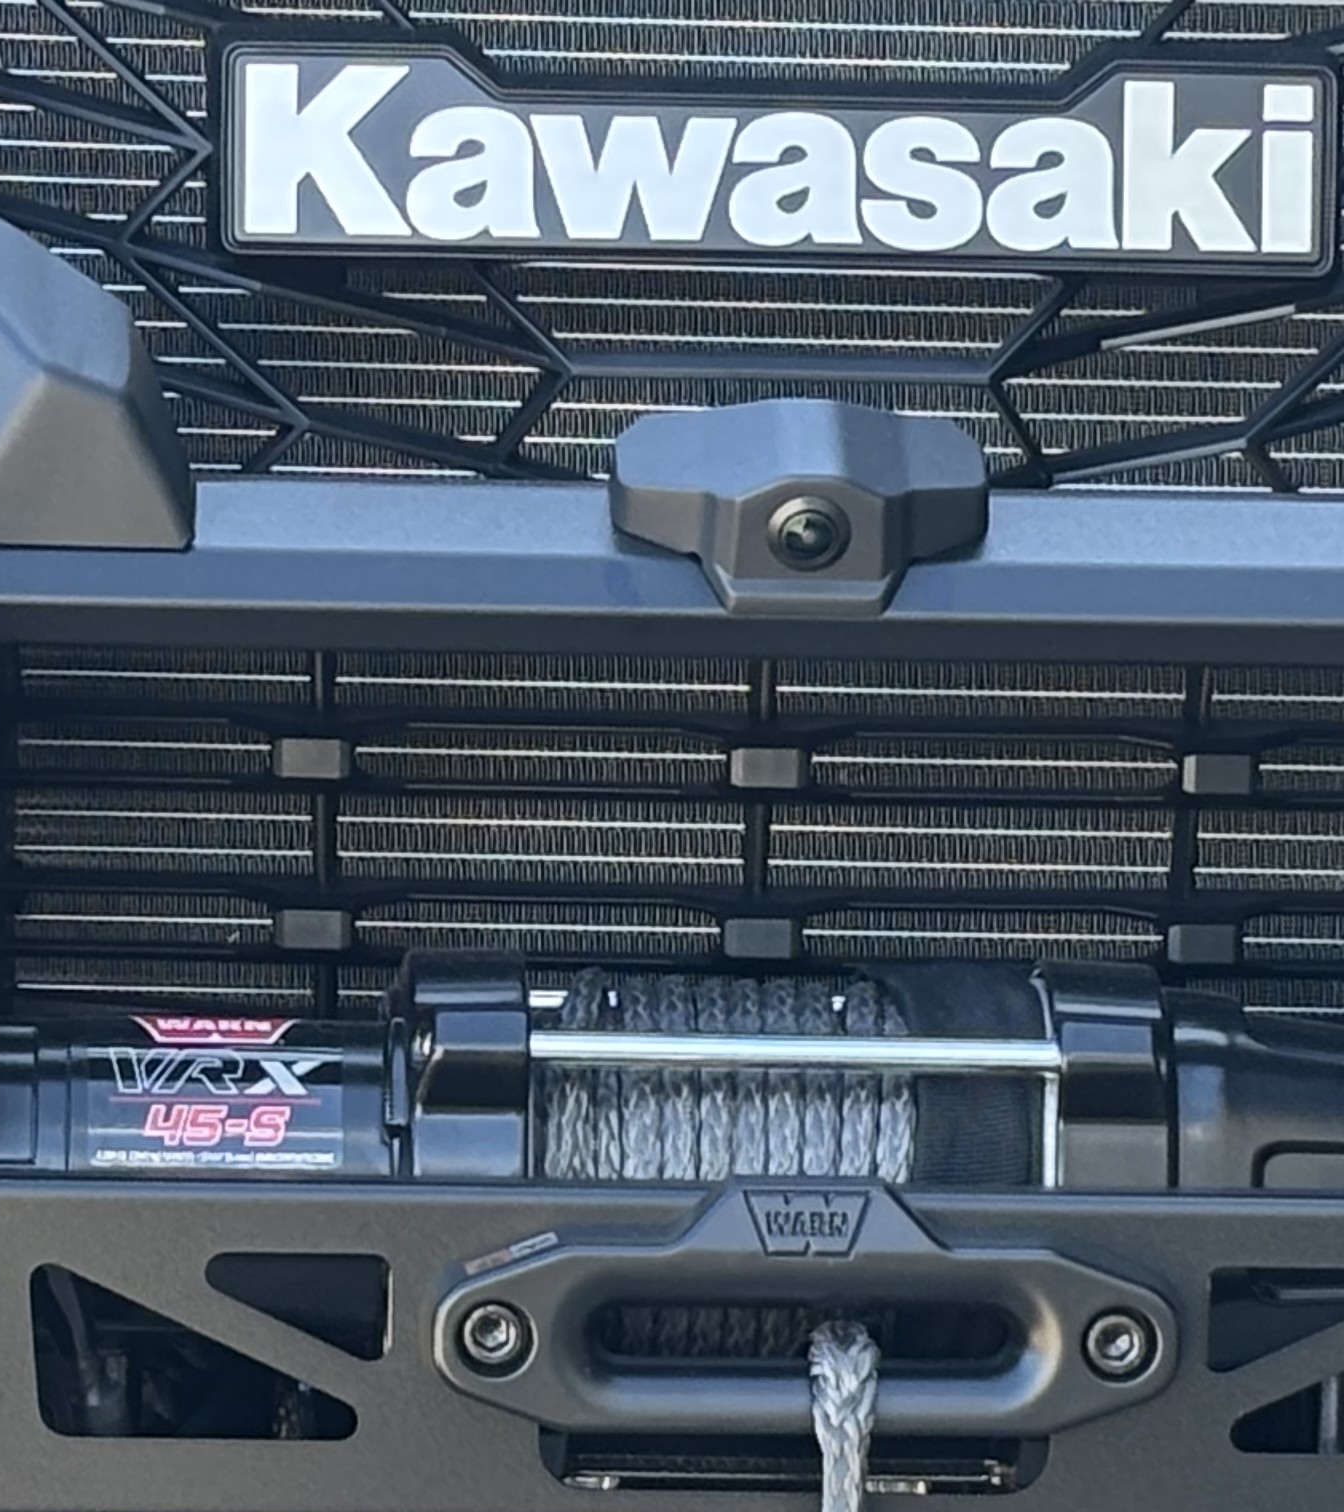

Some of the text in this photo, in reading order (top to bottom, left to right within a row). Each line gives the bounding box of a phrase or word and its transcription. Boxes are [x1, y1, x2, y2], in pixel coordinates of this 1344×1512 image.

[243, 62, 1314, 253] Kawasaki
[157, 1020, 272, 1032] WARN
[108, 1047, 324, 1095] VRX
[143, 1104, 291, 1147] 45-S
[765, 1210, 850, 1238] WARN
